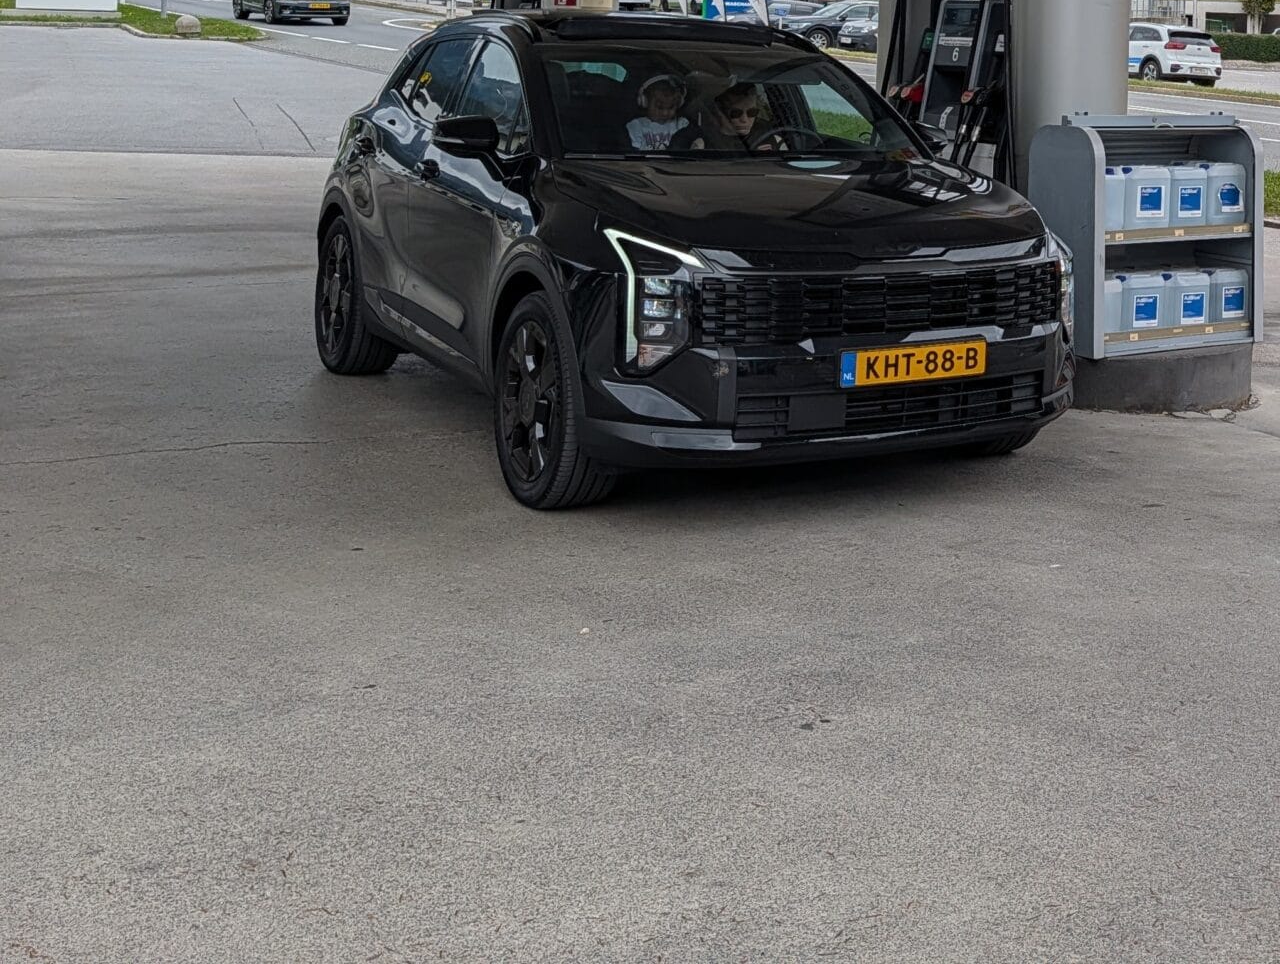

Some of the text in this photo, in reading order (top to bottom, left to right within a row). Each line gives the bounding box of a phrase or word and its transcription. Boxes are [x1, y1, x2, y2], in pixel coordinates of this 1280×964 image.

[952, 47, 960, 62] 6
[865, 347, 979, 380] KHT-88-B
[843, 373, 855, 381] NL
